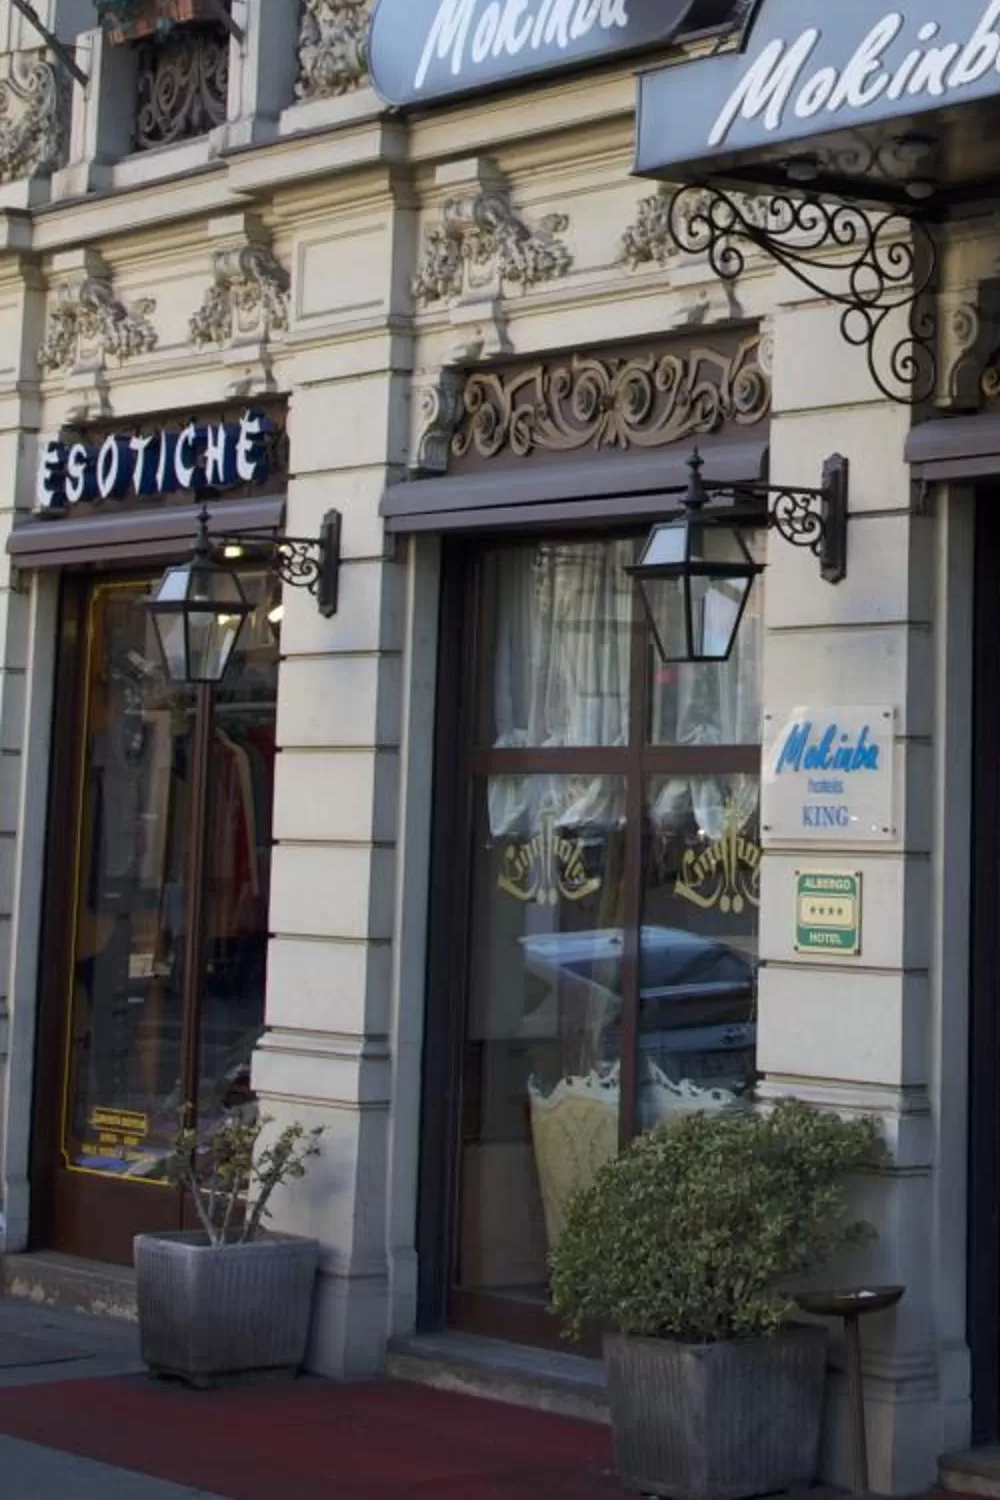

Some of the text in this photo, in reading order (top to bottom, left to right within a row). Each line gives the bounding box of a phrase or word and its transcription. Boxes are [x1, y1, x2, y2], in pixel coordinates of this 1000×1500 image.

[36, 410, 262, 508] ESOTICHE
[803, 805, 849, 827] KING
[803, 875, 852, 891] ALBERGO
[809, 932, 842, 945] HOTEL
